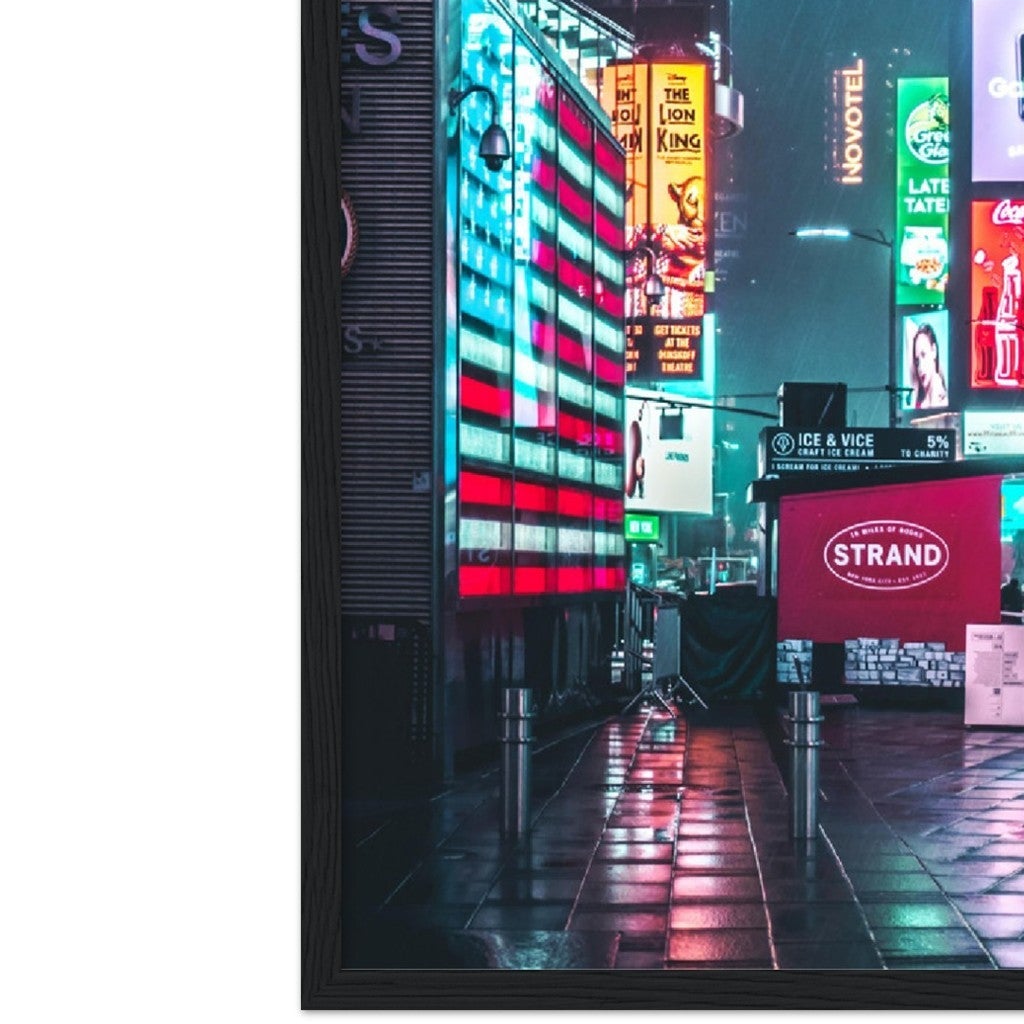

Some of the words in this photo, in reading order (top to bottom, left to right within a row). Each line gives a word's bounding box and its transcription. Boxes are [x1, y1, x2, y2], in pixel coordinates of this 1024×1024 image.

[664, 88, 690, 100] THE
[659, 103, 696, 125] LION
[841, 59, 863, 184] NOVOTEL
[657, 127, 701, 153] KING
[670, 325, 701, 336] TICKETS
[664, 337, 675, 348] AT
[676, 337, 690, 348] THE
[798, 432, 821, 447] ICE
[826, 433, 837, 447] &
[841, 433, 874, 447] VICE
[927, 435, 949, 449] 5%
[797, 448, 825, 457] CRAFT
[827, 448, 841, 457] ICE
[844, 448, 874, 458] CREAM
[901, 449, 911, 457] TO
[914, 449, 949, 458] CHARITY
[777, 463, 804, 471] SCREAM
[806, 463, 819, 471] FOR
[861, 526, 884, 536] MILES
[834, 543, 942, 566] STRAND
